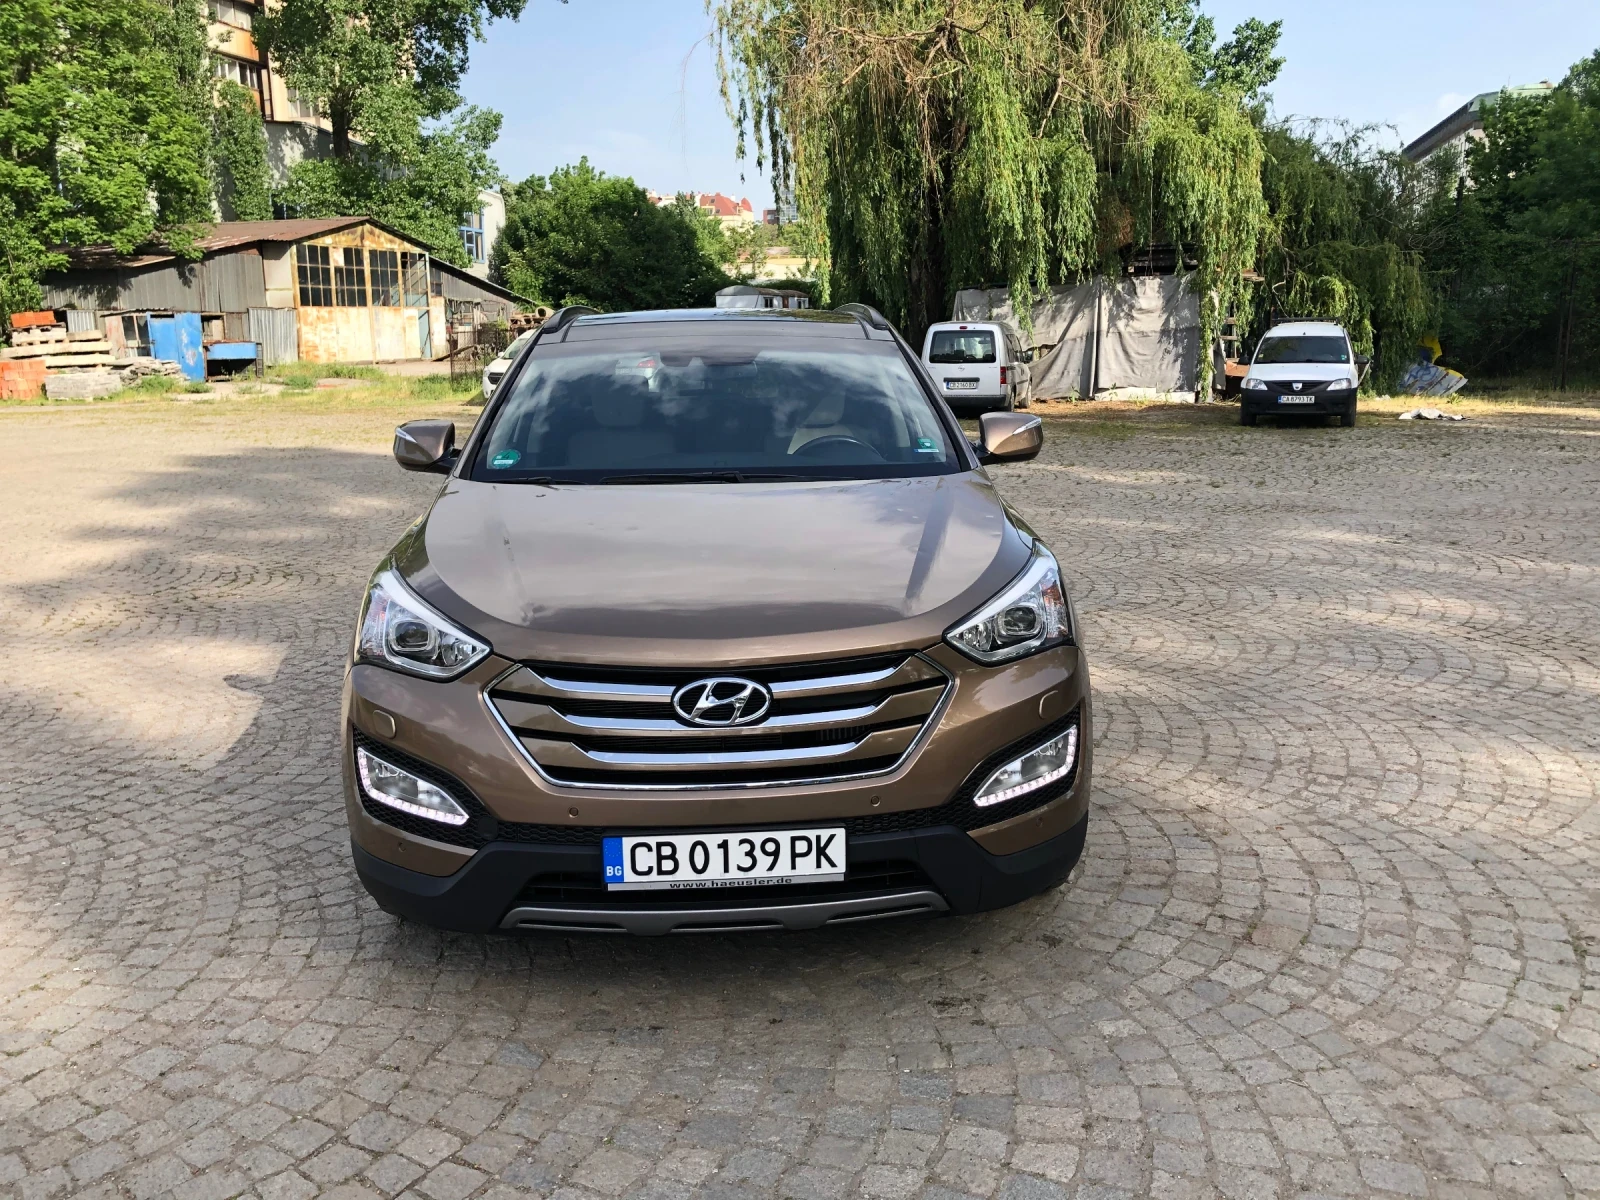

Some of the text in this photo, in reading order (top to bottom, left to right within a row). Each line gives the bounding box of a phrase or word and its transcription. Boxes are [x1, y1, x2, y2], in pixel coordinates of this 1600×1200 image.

[629, 833, 838, 877] CB 0139 PK
[606, 865, 622, 877] BG
[669, 877, 792, 889] www.haeusler.de
